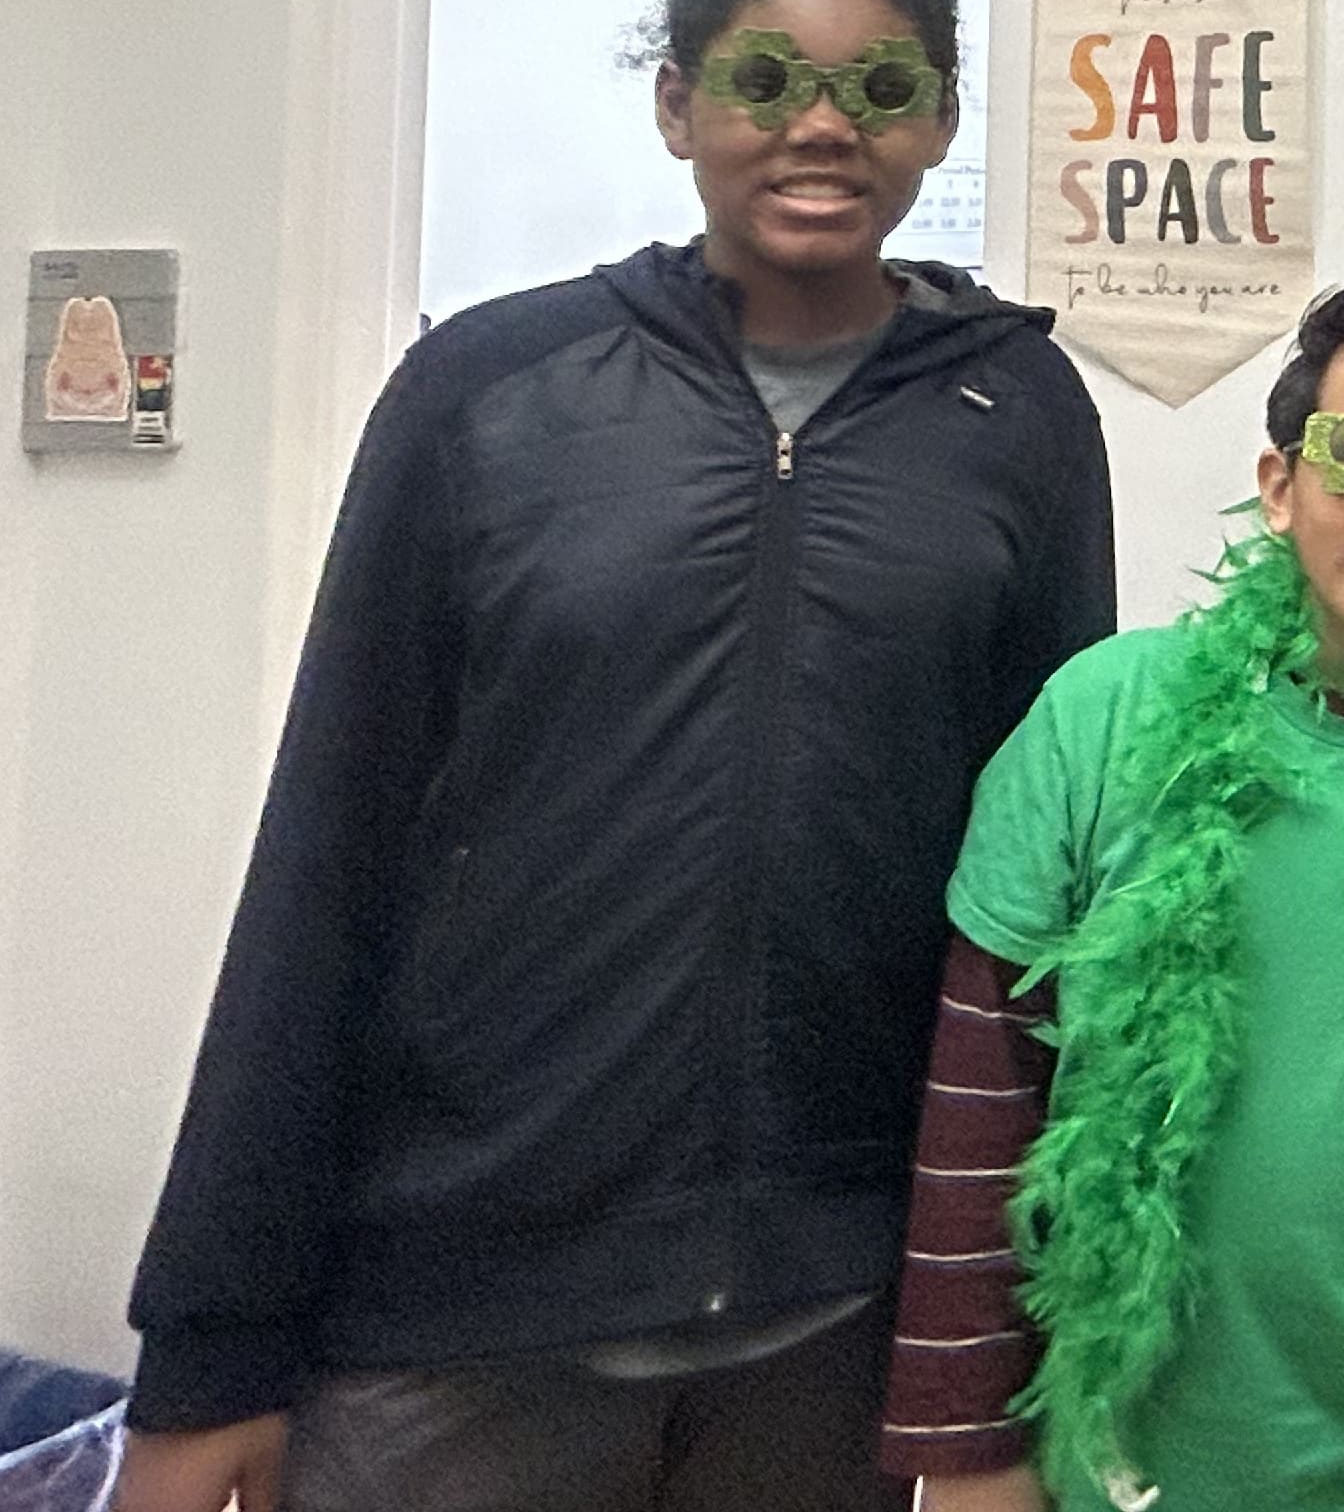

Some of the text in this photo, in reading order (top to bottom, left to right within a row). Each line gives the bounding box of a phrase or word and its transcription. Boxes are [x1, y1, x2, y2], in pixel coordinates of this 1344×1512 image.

[1068, 31, 1276, 143] SAFE
[1060, 157, 1280, 244] SPACE
[1096, 262, 1127, 296] be
[1136, 262, 1187, 296] who
[1196, 284, 1233, 314] you
[1241, 284, 1282, 296] are
